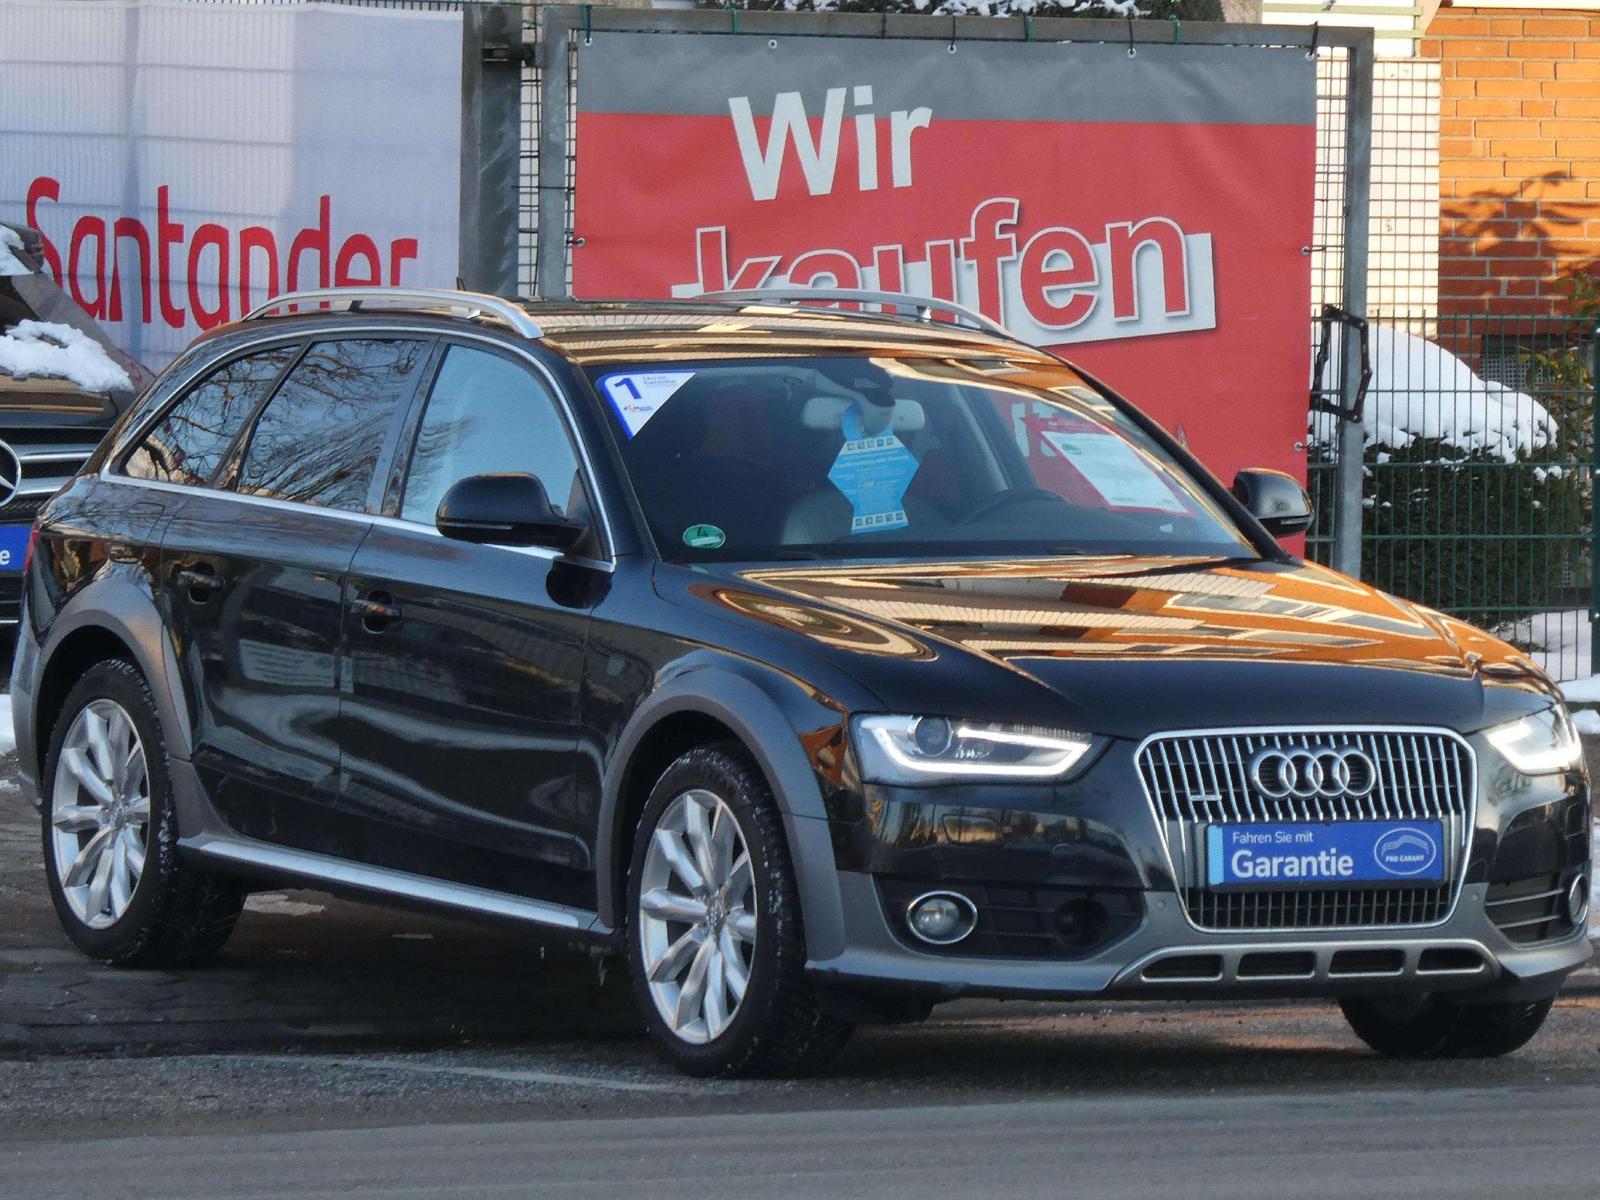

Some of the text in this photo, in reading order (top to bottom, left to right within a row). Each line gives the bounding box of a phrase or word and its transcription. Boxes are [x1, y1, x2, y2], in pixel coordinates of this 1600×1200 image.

[728, 84, 933, 202] Wir
[26, 175, 419, 332] Santander
[614, 377, 642, 400] 1
[1232, 830, 1314, 844] Fahren Sie mit
[1231, 847, 1355, 879] Garantie
[1385, 854, 1425, 863] PRO GARANT
